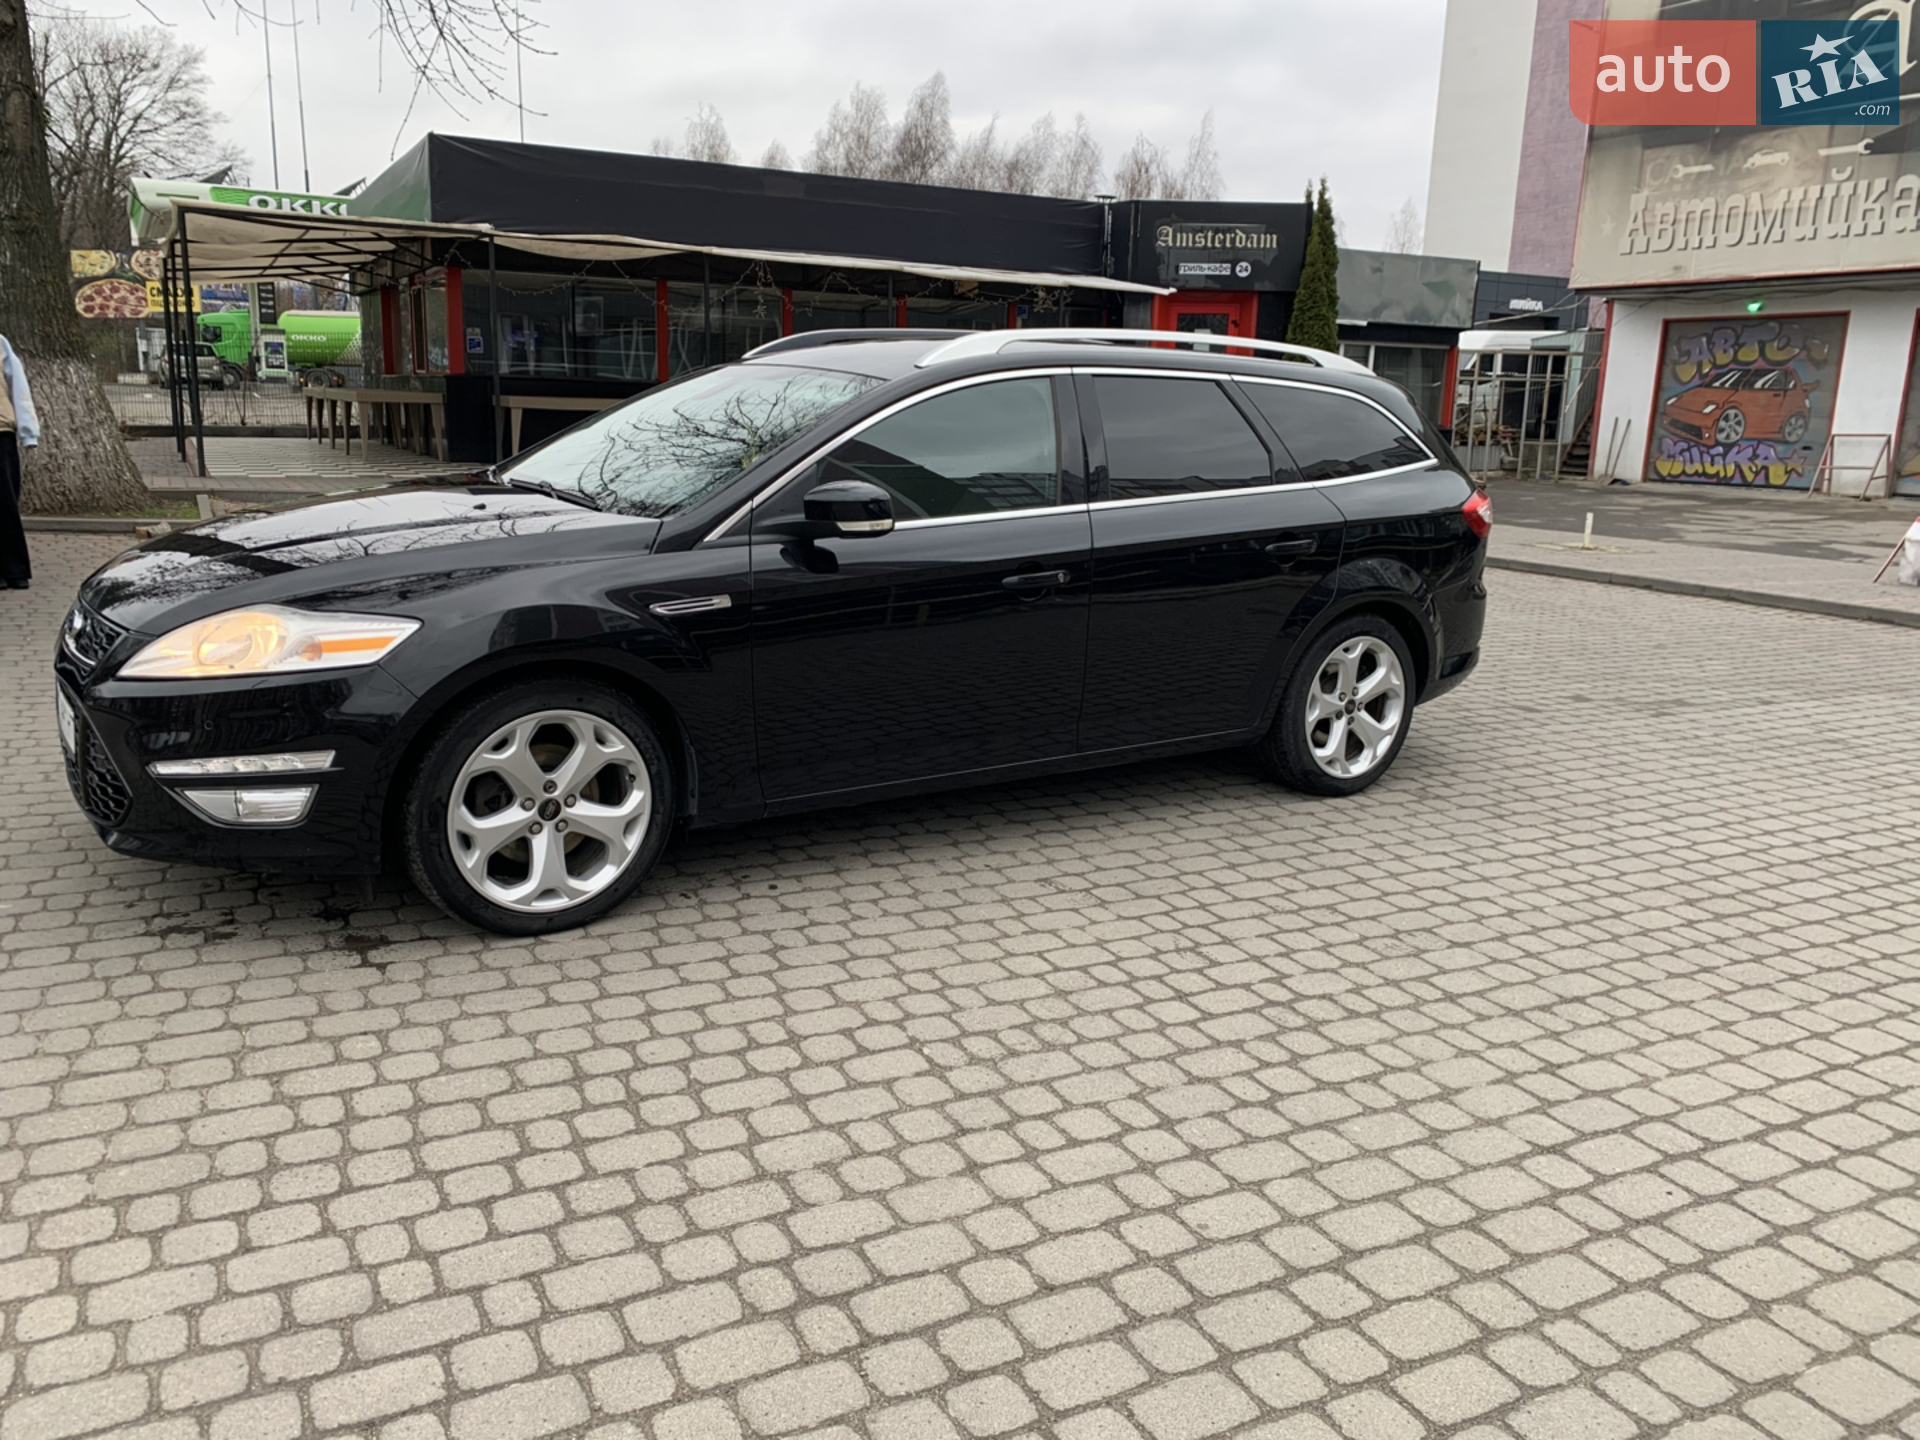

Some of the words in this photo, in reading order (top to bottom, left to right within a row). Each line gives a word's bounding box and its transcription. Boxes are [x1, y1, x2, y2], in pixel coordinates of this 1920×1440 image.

[1619, 166, 1920, 256] Автомийка
[1155, 225, 1278, 249] Amsterdam
[1238, 264, 1249, 273] 24
